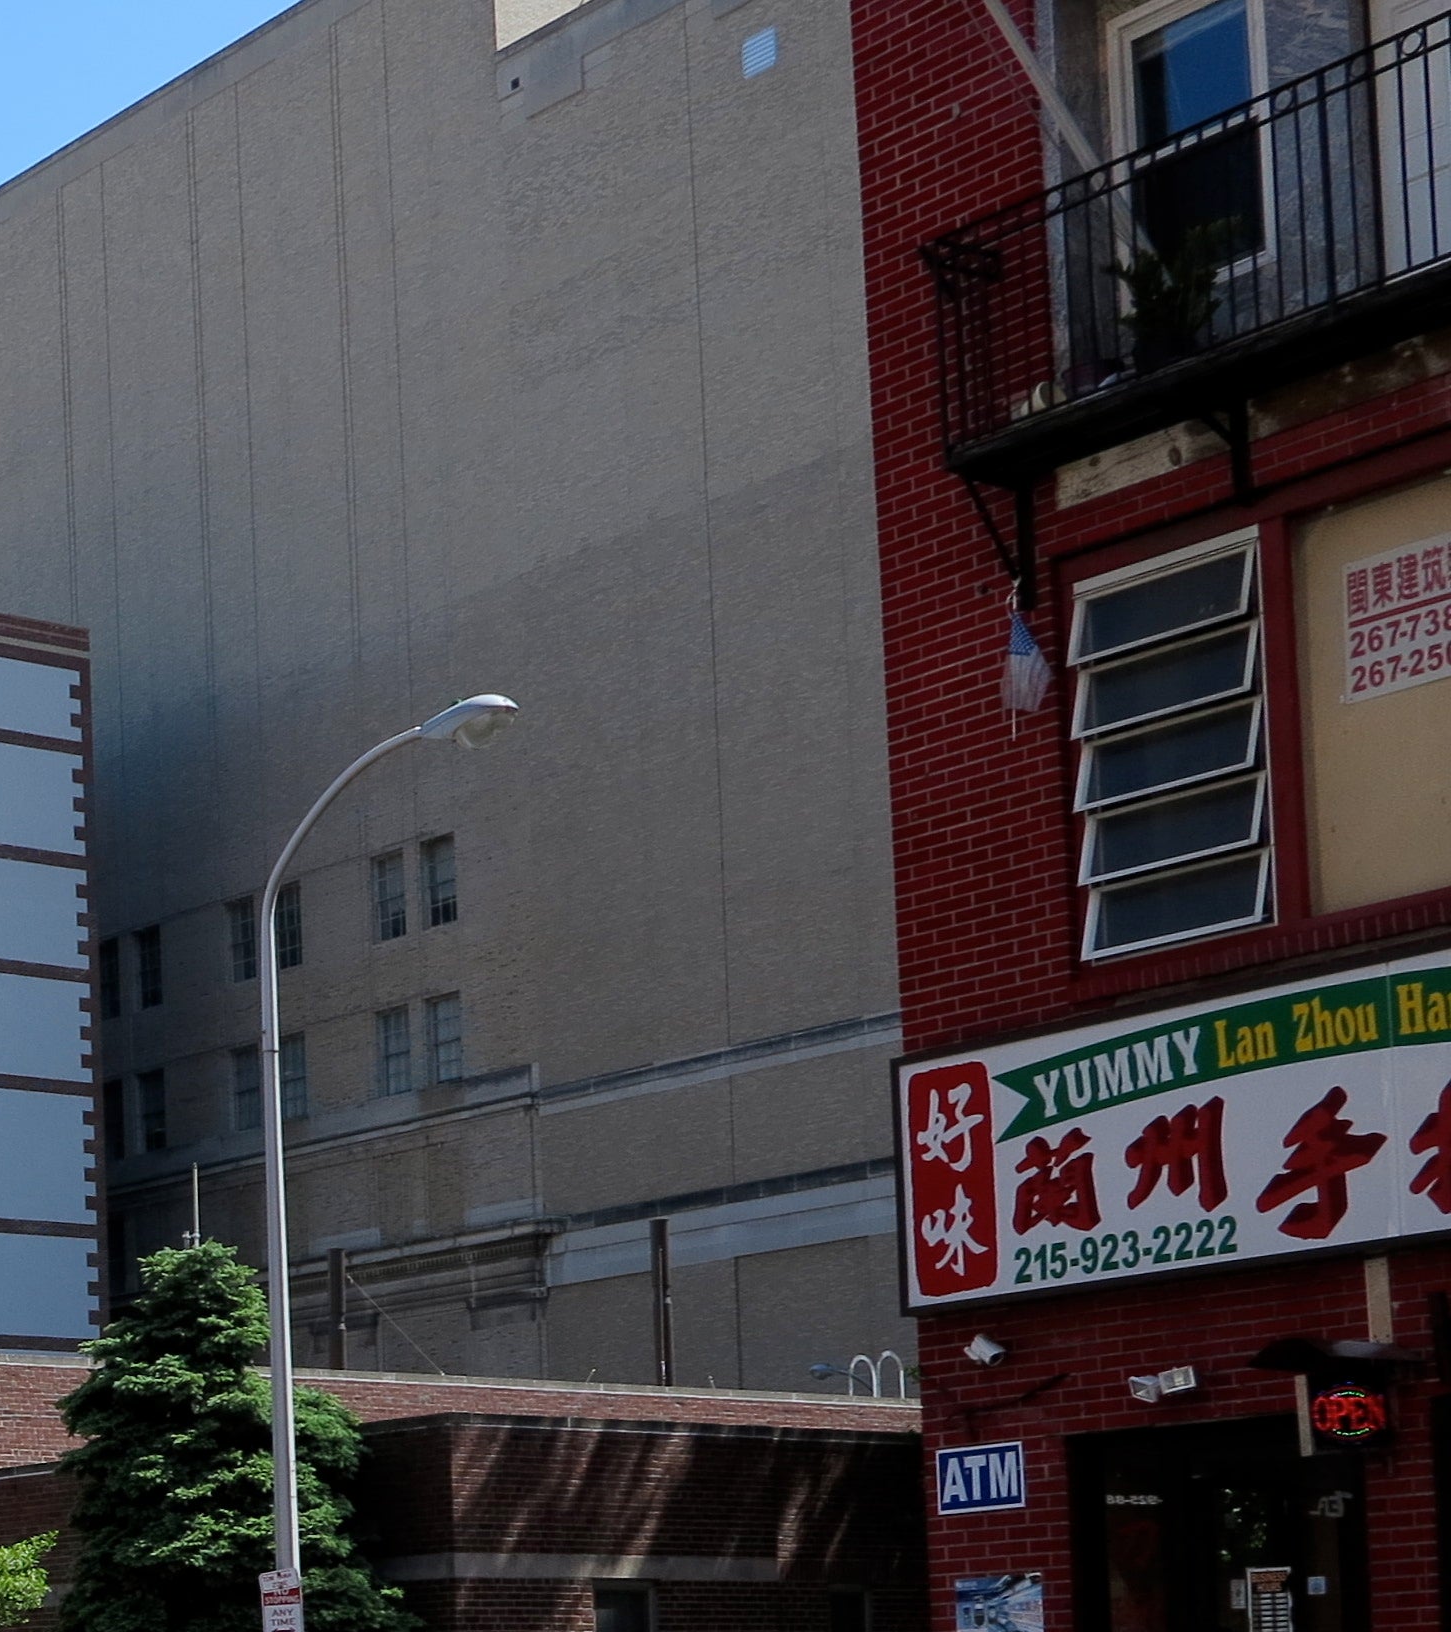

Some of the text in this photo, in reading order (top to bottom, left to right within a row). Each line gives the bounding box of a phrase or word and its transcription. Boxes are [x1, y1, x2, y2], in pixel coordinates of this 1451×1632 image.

[1033, 982, 1451, 1120] YUMMY Lan Zhou Ha
[916, 1081, 989, 1278] 好味
[1013, 1215, 1238, 1285] 215-923-2222
[1313, 1395, 1386, 1431] OPEN
[942, 1451, 1019, 1504] ATM
[270, 1617, 296, 1626] TIME
[271, 1608, 294, 1617] ANY
